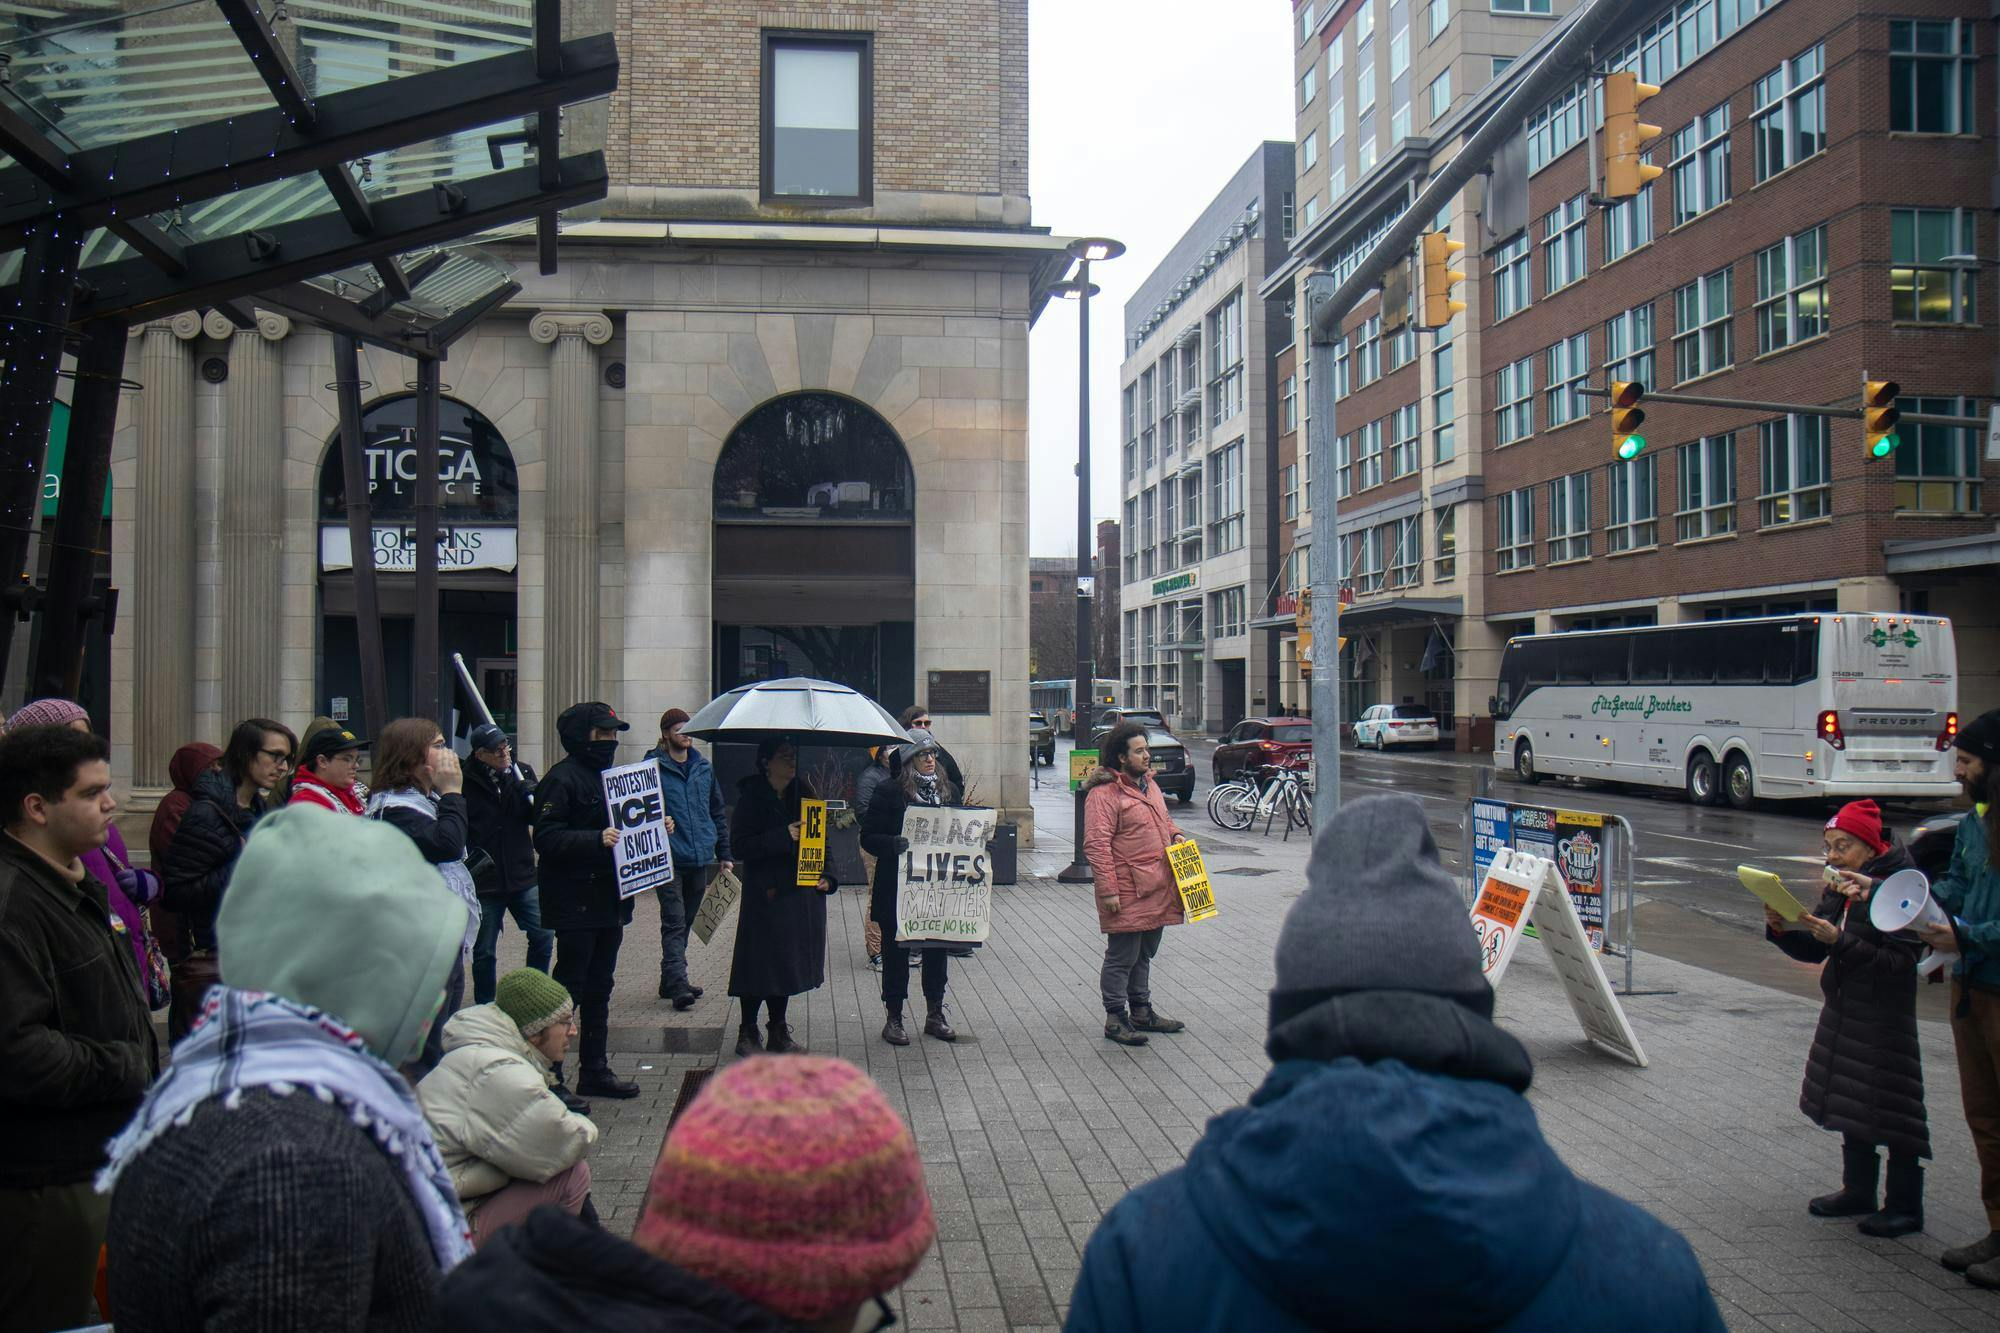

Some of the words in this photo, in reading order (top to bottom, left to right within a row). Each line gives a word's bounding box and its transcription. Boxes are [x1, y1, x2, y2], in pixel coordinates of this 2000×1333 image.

[368, 482, 481, 494] PLCE
[1591, 694, 1644, 718] FitzGerald
[1643, 694, 1692, 719] Brothers
[605, 767, 658, 800] PROTESTING
[611, 793, 662, 831] ICE
[806, 806, 822, 839] ICE
[1474, 803, 1507, 822] DOWNTOWN
[1521, 809, 1539, 820] MORE
[1539, 812, 1548, 820] TO
[1521, 818, 1548, 830] EXPLORE
[914, 817, 995, 847] BLACK
[1475, 818, 1496, 836] ITHACA
[624, 836, 635, 860] IS
[635, 830, 653, 857] NOT
[655, 828, 662, 851] A
[1475, 834, 1489, 851] GIFT
[620, 852, 668, 879] CRIME!
[906, 851, 986, 884] LIVES
[696, 873, 731, 919] BACK
[1182, 883, 1200, 894] SHUT
[1201, 880, 1208, 888] IT
[705, 887, 737, 938] FIGHT
[901, 885, 989, 922] MATTER
[904, 919, 919, 936] NO
[921, 919, 941, 931] ICE
[943, 919, 957, 934] NO
[960, 921, 977, 935] KKK
